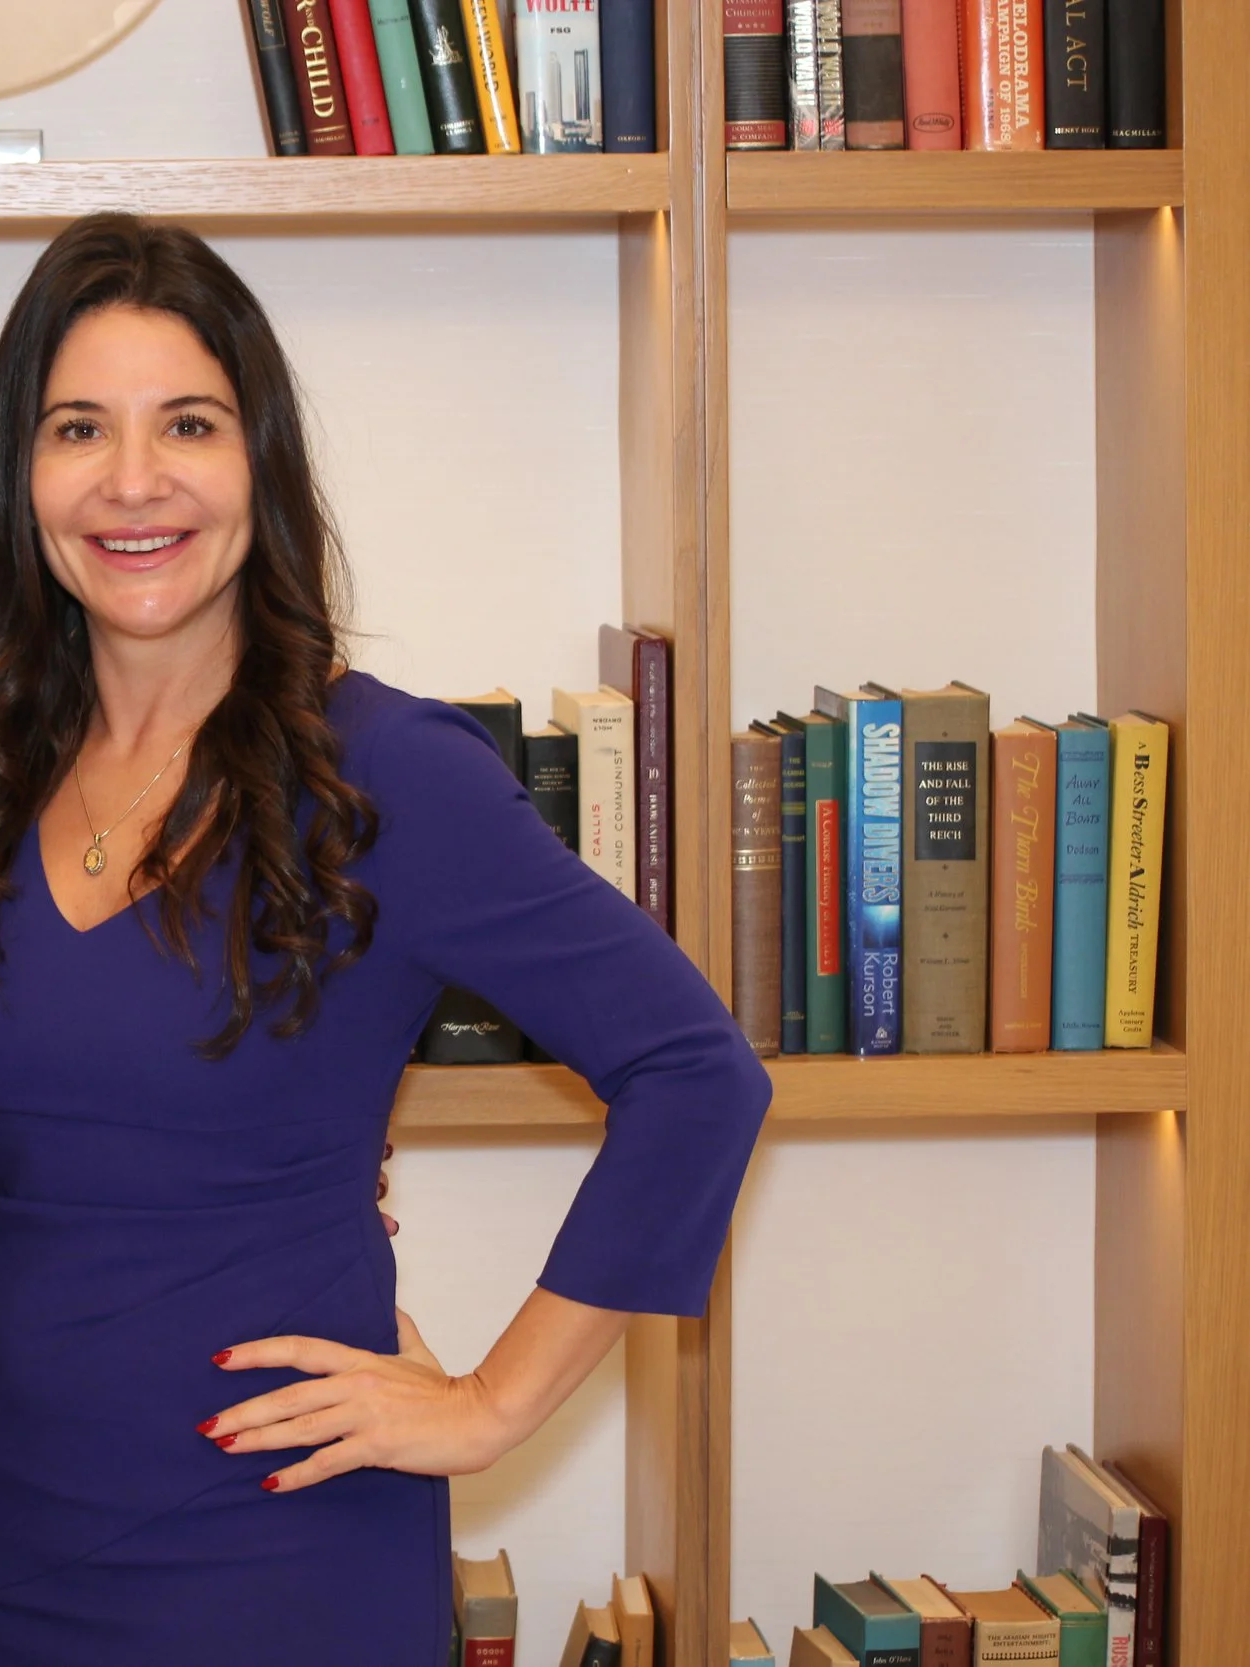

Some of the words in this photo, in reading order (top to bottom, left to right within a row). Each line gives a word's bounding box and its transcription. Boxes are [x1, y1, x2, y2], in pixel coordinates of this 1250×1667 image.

[725, 8, 775, 18] CHURCHILL
[793, 0, 814, 53] WORLD
[300, 26, 336, 118] CHILD
[796, 55, 815, 91] WAR
[819, 56, 840, 92] WAR
[1012, 0, 1030, 129] ELODRAMA
[1066, 35, 1088, 93] ACT
[797, 93, 815, 106] II
[999, 80, 1011, 104] OF
[999, 107, 1012, 142] 1968
[1054, 126, 1080, 135] HENRY
[1081, 125, 1101, 134] HOLT
[1111, 129, 1162, 138] MACMILLAN
[1138, 741, 1147, 750] A
[862, 723, 900, 818] SHADOW
[921, 760, 944, 772] THE
[945, 760, 969, 772] RISE
[1010, 752, 1041, 799] The
[1132, 753, 1151, 798] Bess
[613, 748, 624, 832] COMMUNIST
[735, 778, 778, 792] Collected
[918, 779, 944, 789] AND
[945, 779, 972, 789] FALL
[751, 808, 762, 824] of
[822, 807, 833, 817] A
[925, 795, 940, 806] OF
[943, 795, 964, 806] THE
[591, 803, 601, 857] CALLIS
[927, 812, 962, 823] THIRD
[1129, 796, 1150, 863] Streeter
[929, 829, 962, 840] REICH
[1008, 804, 1040, 875] Thorn
[1066, 843, 1100, 856] Dodson
[614, 839, 624, 868] AND
[862, 822, 900, 903] DIVERS
[1014, 880, 1039, 934] Birds
[1127, 862, 1146, 932] Aldrich
[1128, 933, 1140, 996] TREASURY
[863, 951, 880, 1017] Kurson
[882, 953, 899, 1016] Robert
[440, 1021, 471, 1036] Harper
[1118, 1009, 1146, 1018] Appleton
[987, 1634, 1001, 1642] THE
[872, 1656, 887, 1665] John
